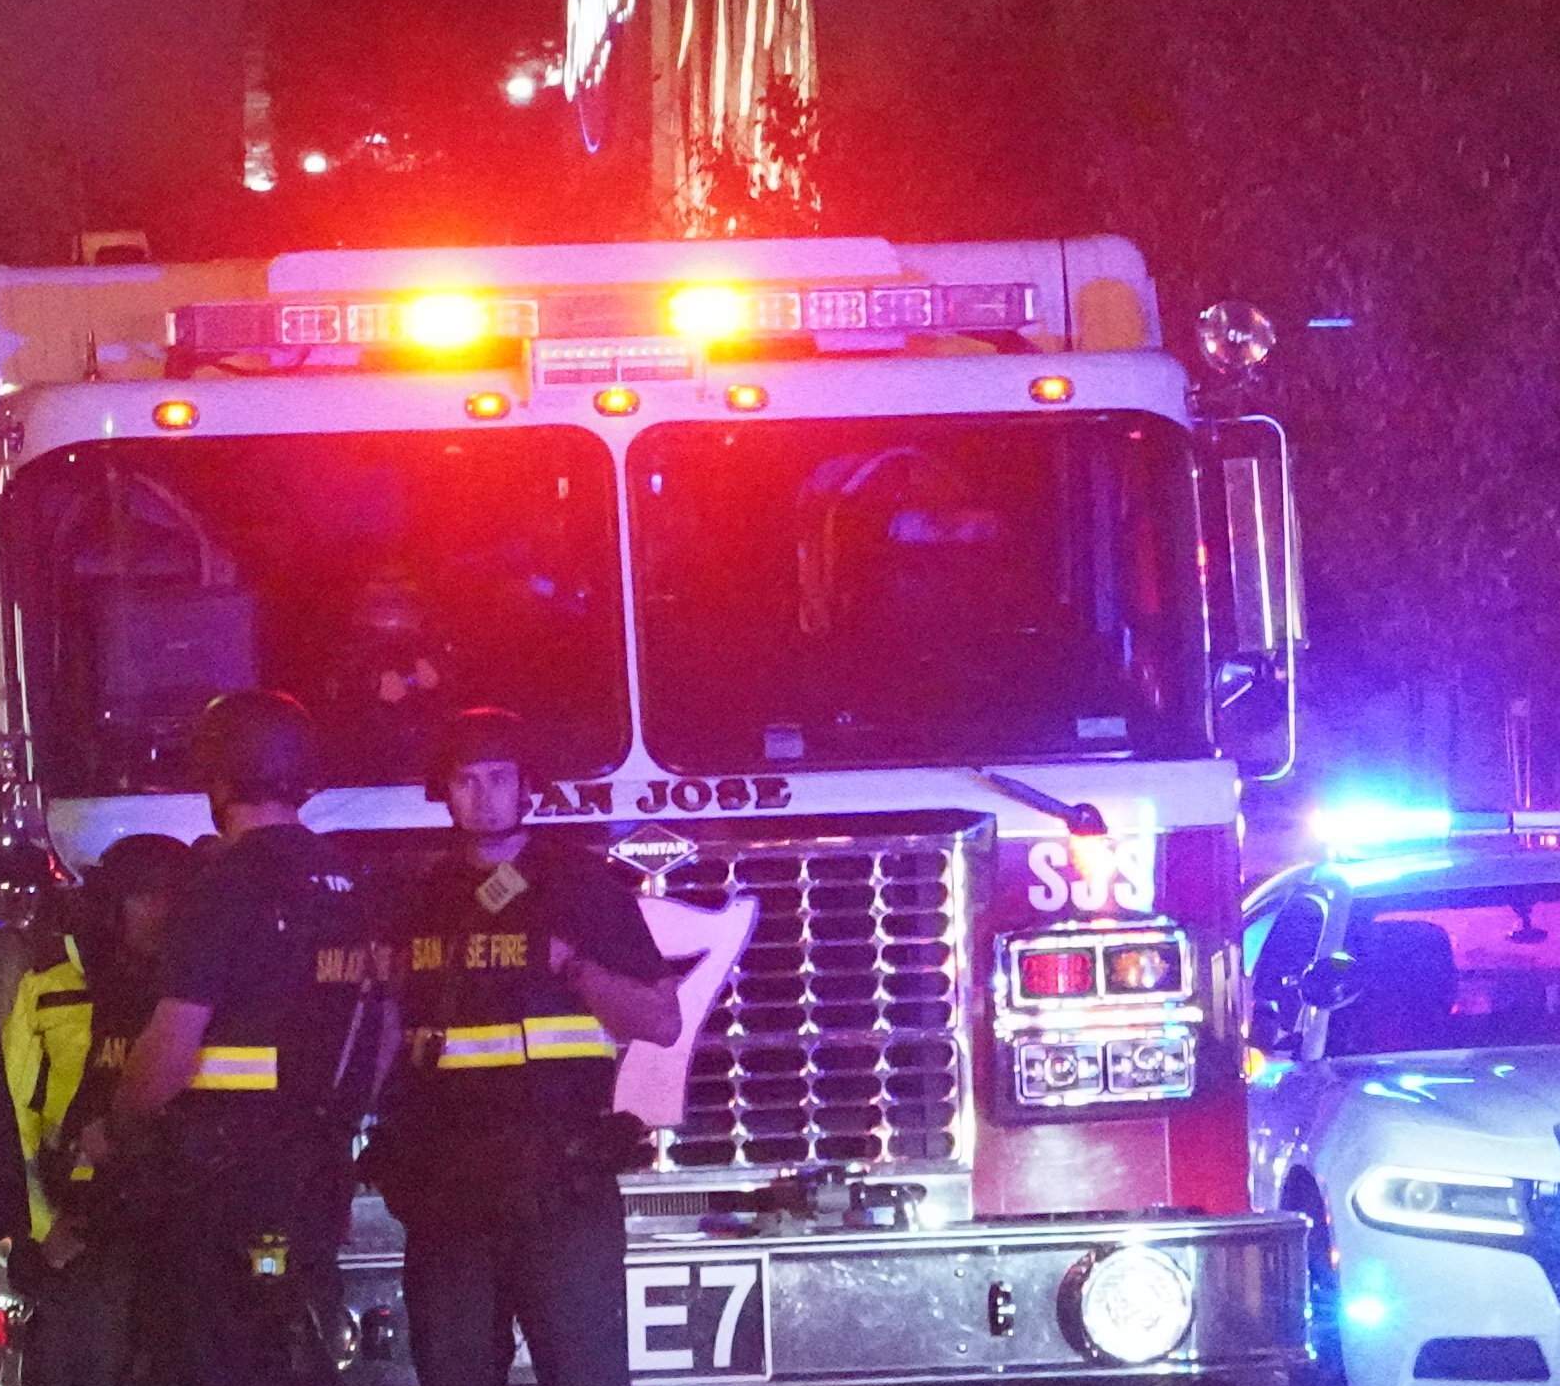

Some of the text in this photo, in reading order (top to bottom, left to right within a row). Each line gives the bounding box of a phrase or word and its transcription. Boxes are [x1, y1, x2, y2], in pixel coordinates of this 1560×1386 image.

[528, 777, 792, 817] AN JOSE
[619, 842, 689, 857] SPARTAN
[490, 932, 528, 967] FIRE
[626, 1265, 757, 1371] E7
